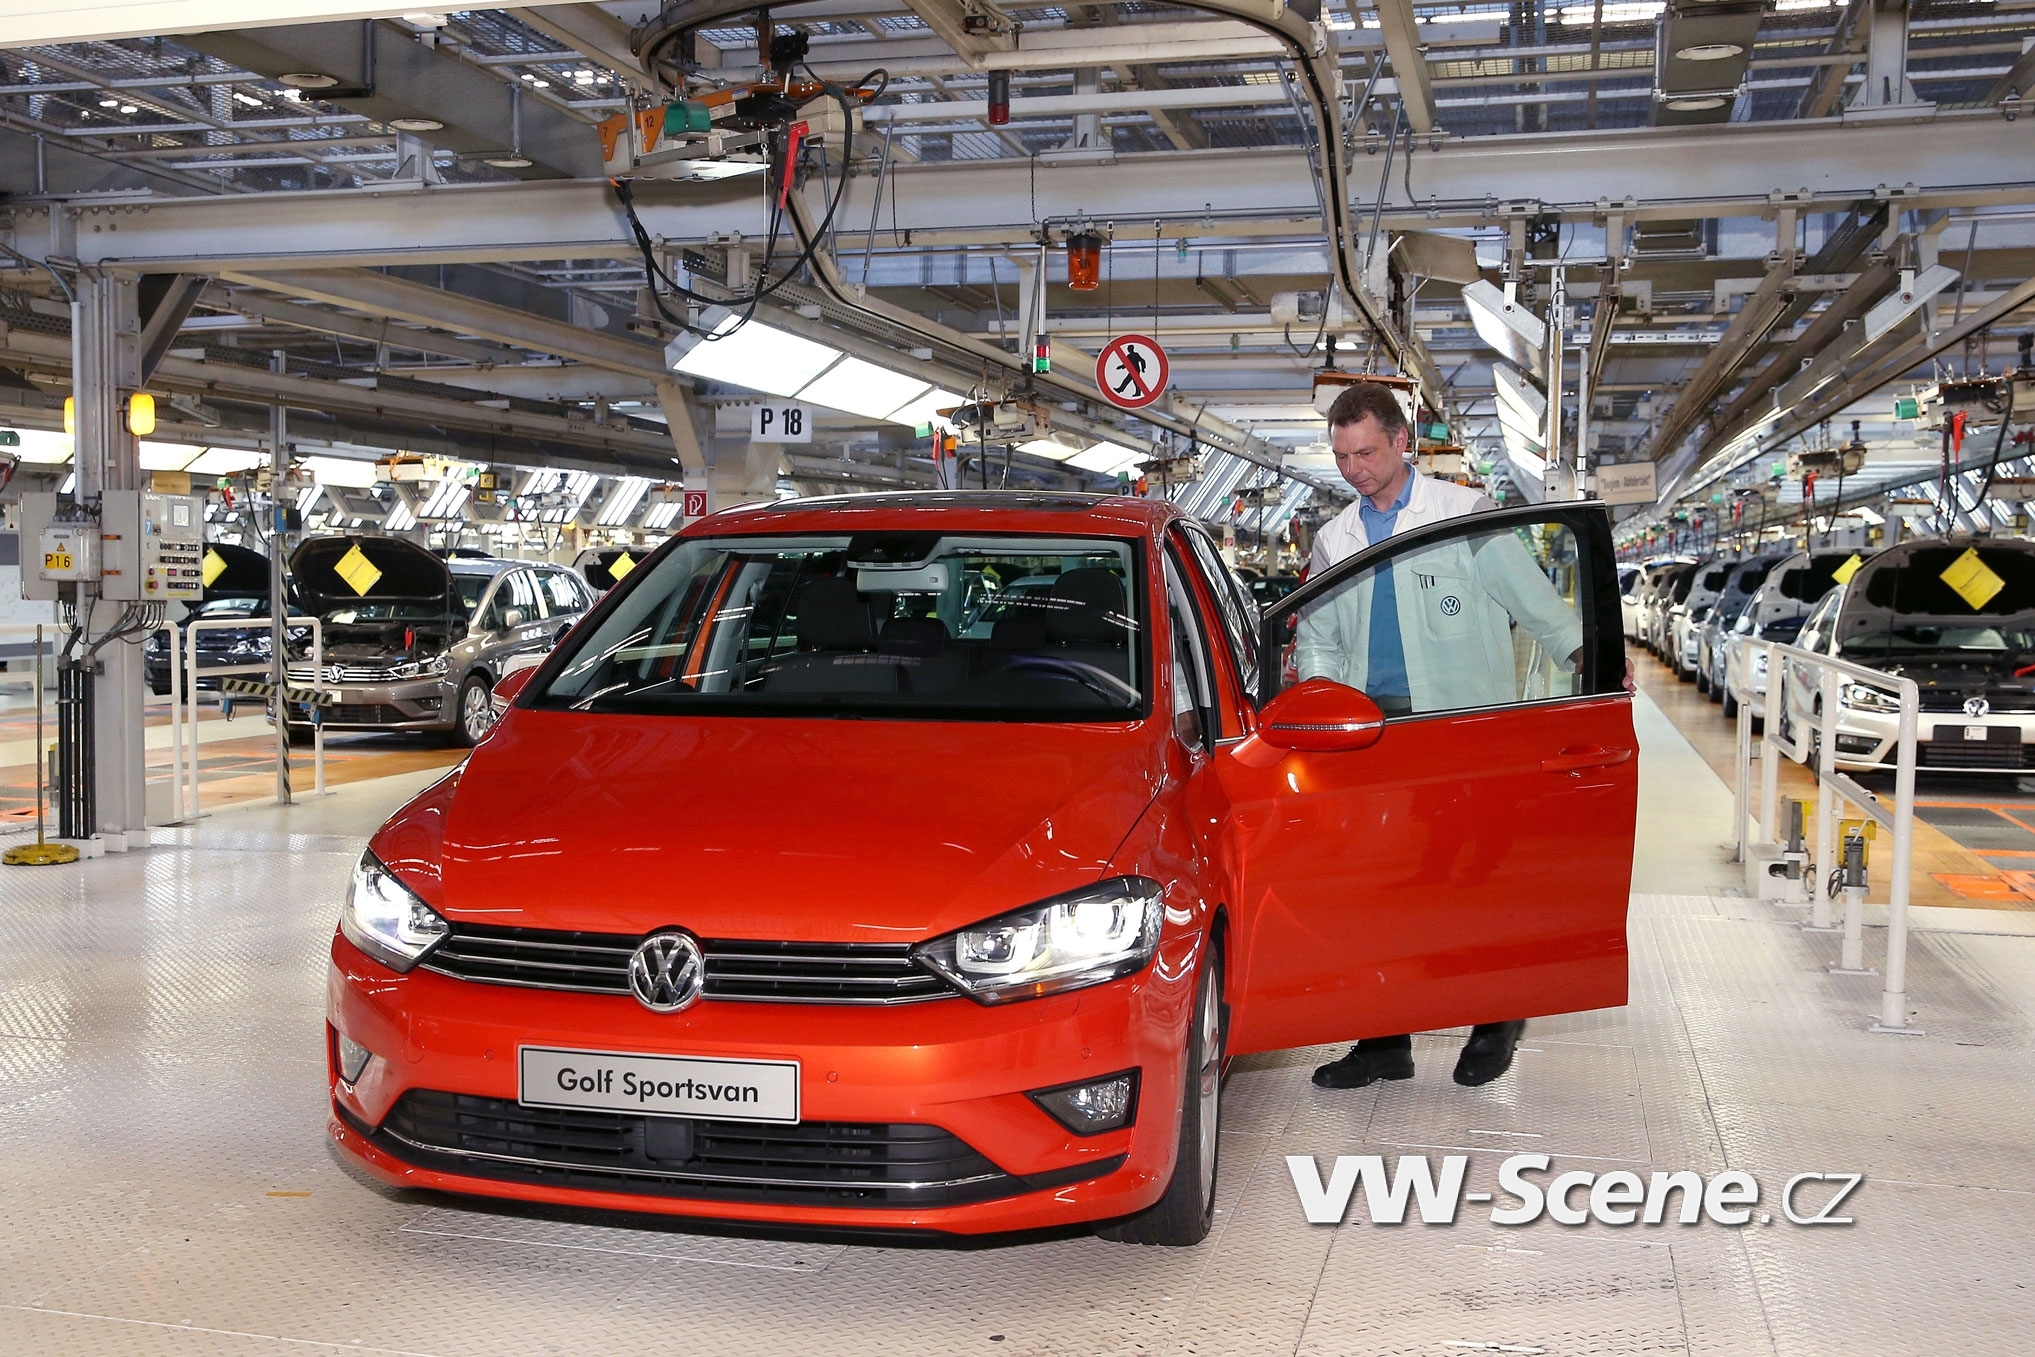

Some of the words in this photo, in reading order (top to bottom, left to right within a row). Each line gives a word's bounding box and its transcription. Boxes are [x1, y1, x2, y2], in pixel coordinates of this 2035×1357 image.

[645, 115, 654, 129] 12
[761, 408, 773, 435] P
[782, 408, 802, 436] 18
[557, 1067, 613, 1094] Golf
[623, 1071, 758, 1103] Sportsvan
